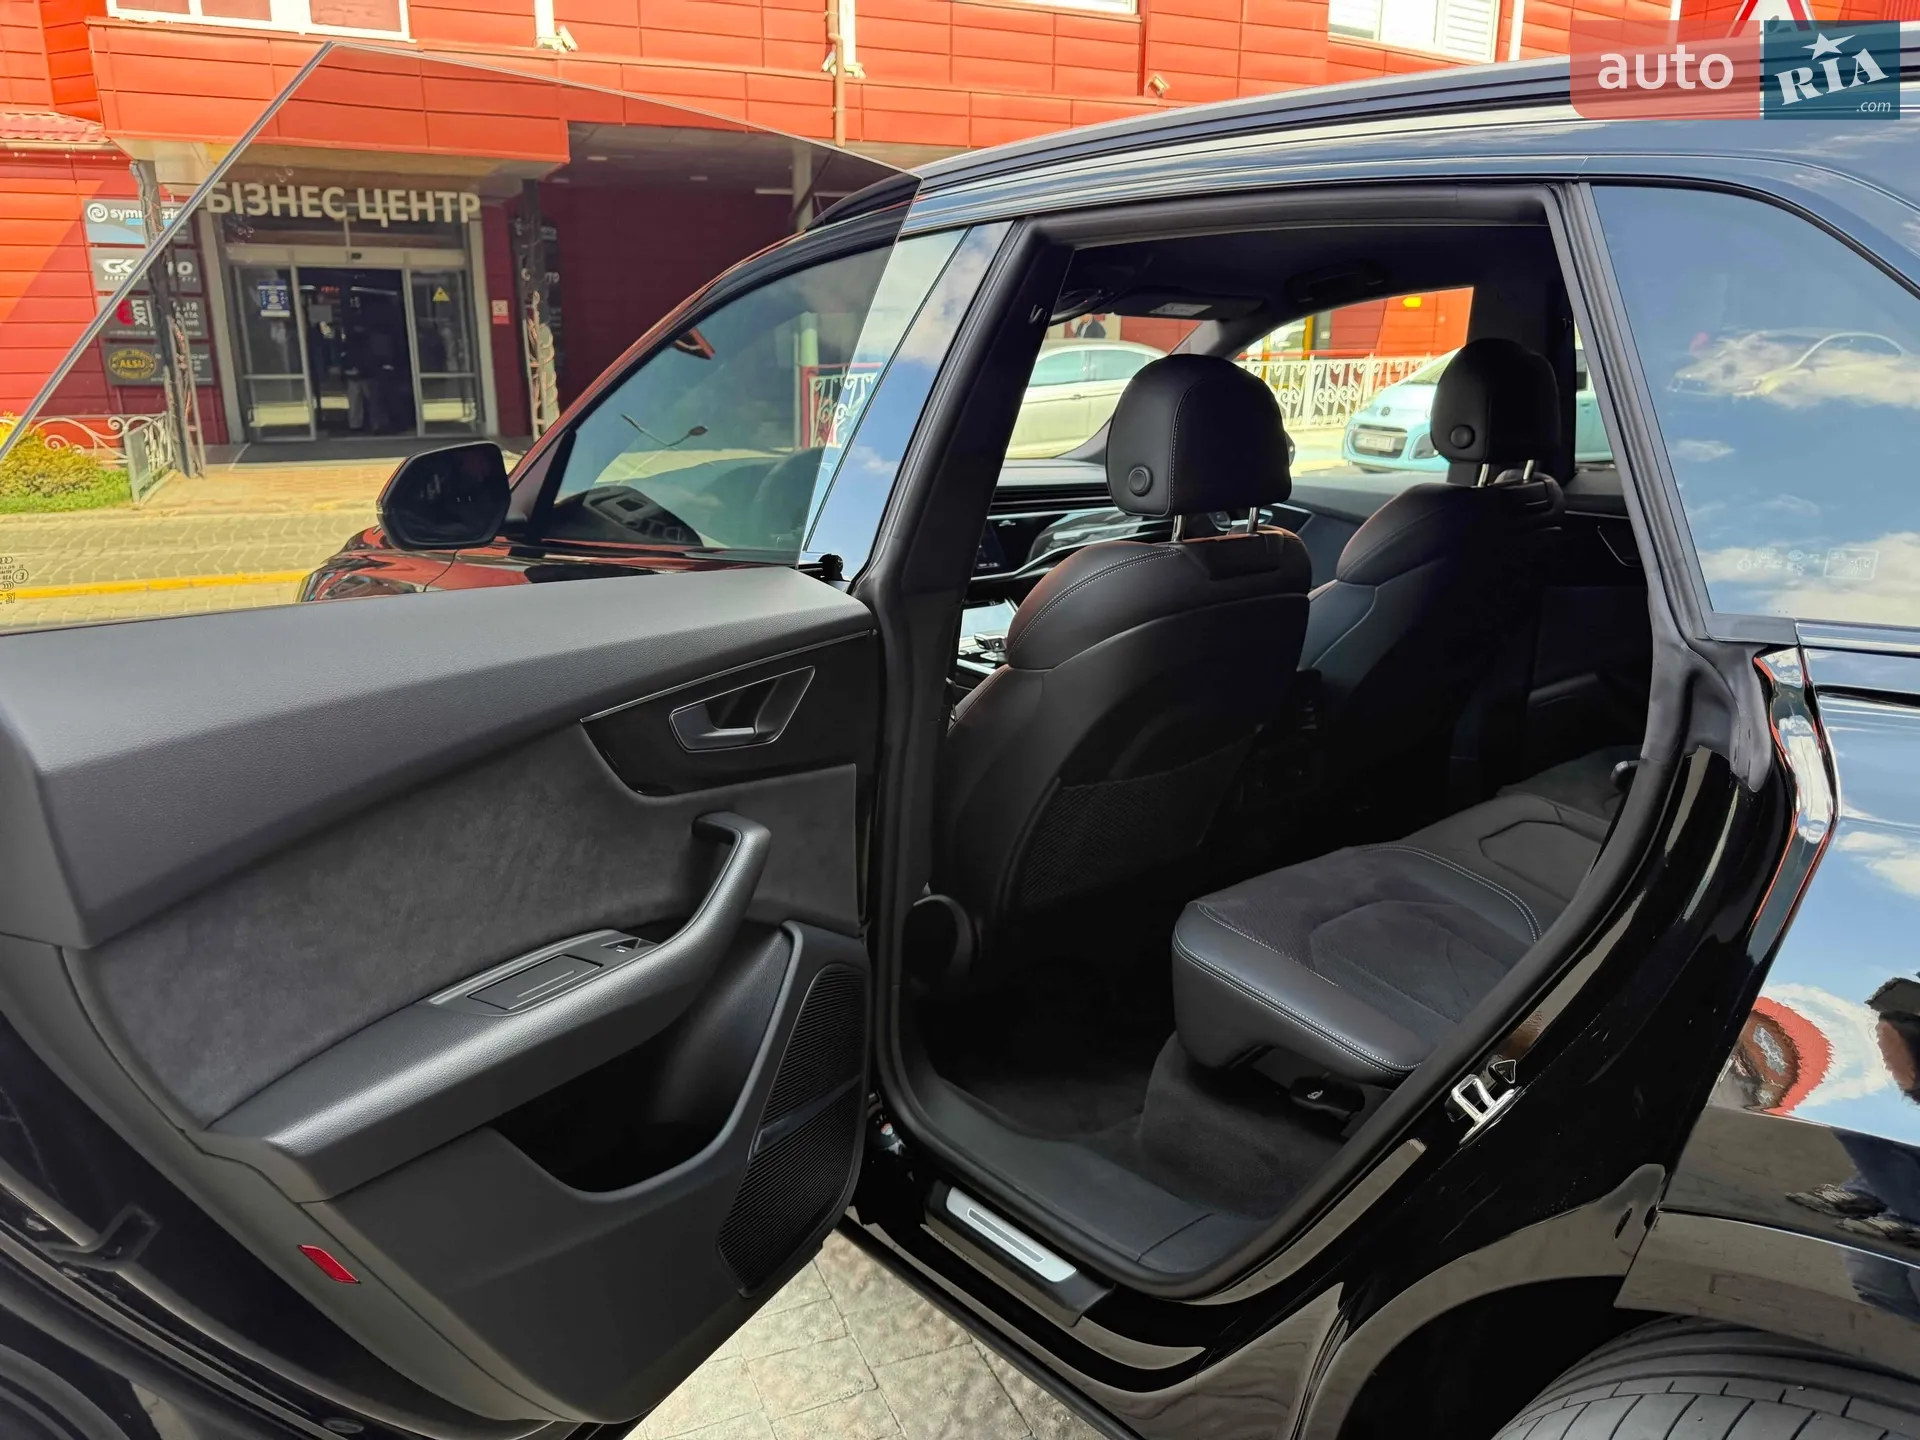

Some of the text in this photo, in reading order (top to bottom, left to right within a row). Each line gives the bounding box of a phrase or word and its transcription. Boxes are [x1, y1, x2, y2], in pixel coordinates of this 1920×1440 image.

[205, 181, 481, 228] БІЗНЕС ЦЕНТР
[130, 299, 149, 326] LUX
